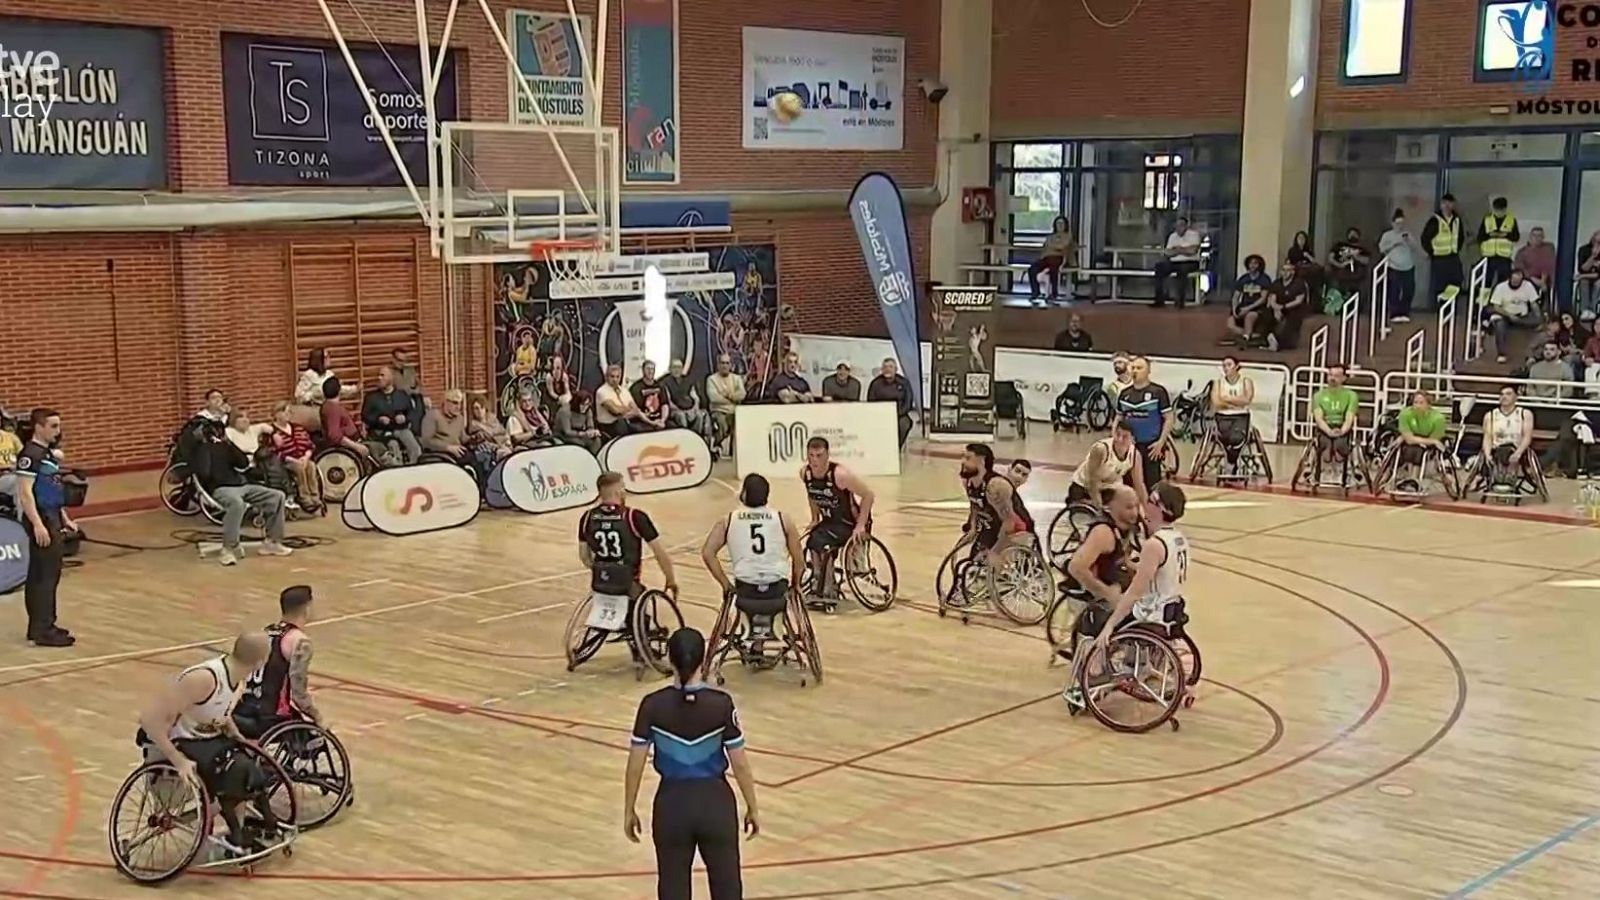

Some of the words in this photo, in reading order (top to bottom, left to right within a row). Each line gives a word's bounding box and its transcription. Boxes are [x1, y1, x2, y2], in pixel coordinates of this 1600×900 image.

[518, 79, 583, 96] AUNTAMIENTO
[363, 112, 428, 131] dporte
[11, 112, 148, 155] MANGUÁN
[255, 149, 330, 167] TIZONA
[300, 169, 330, 179] sport
[944, 292, 986, 305] SCORED
[627, 457, 696, 482] FEDDF
[594, 531, 622, 557] 33
[750, 523, 765, 555] 5
